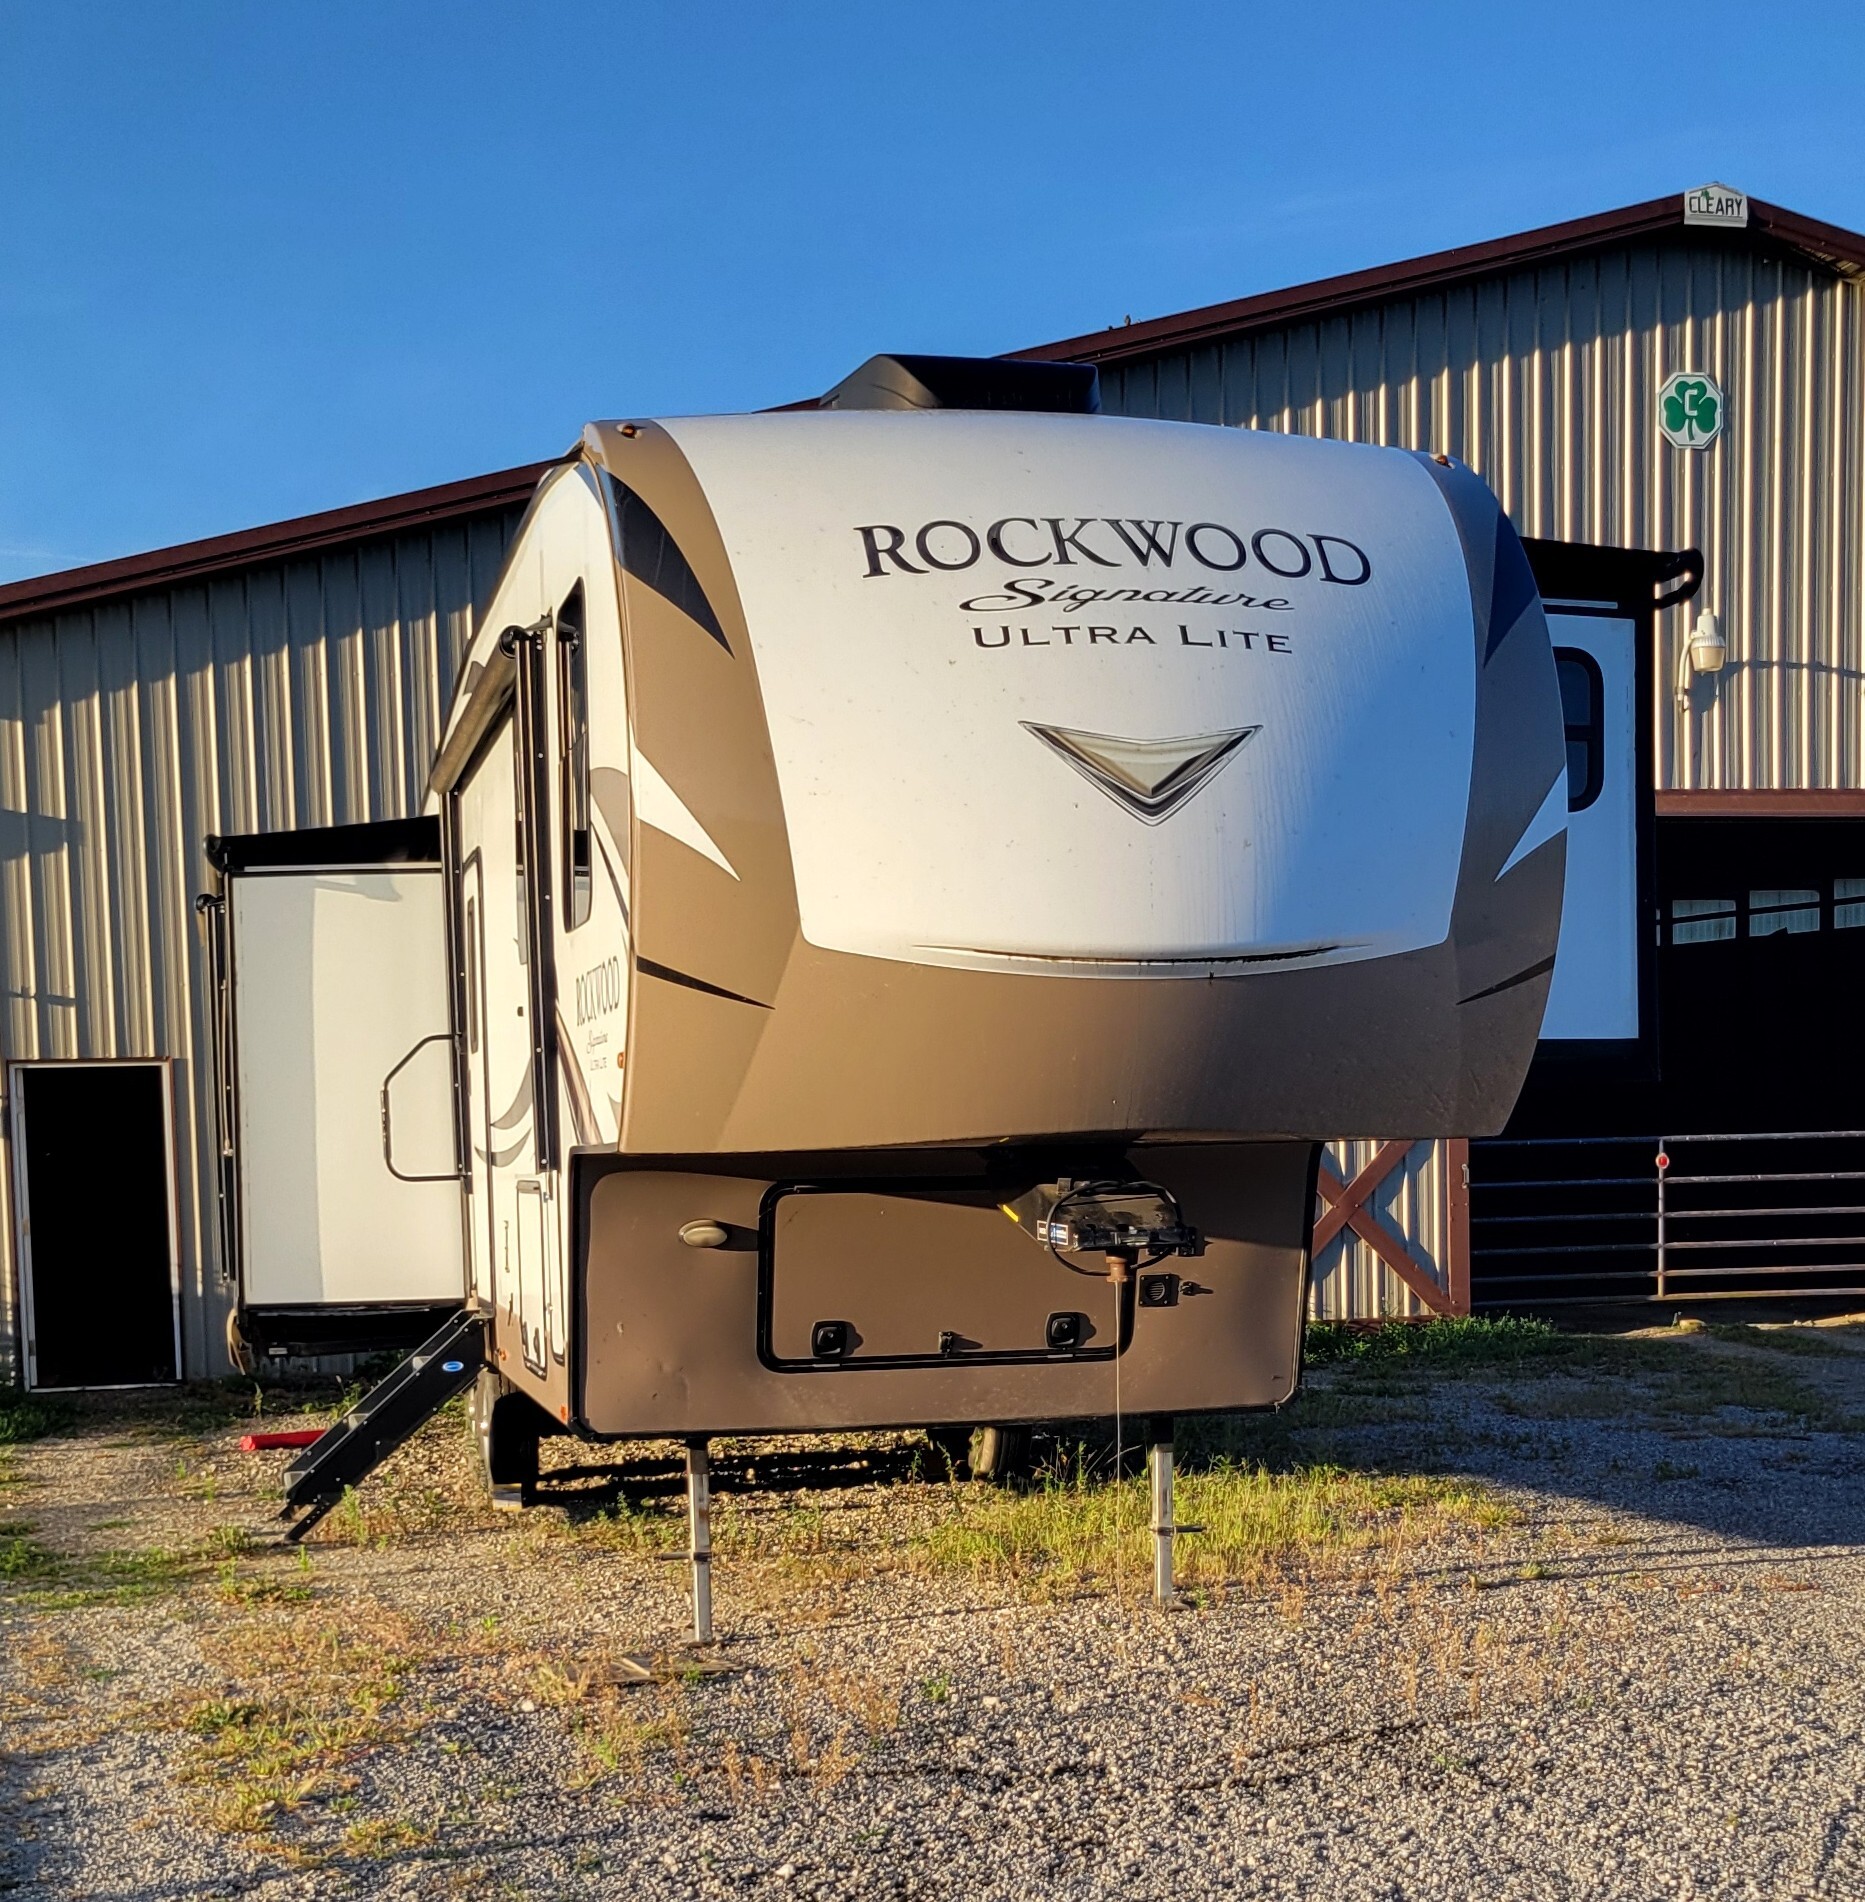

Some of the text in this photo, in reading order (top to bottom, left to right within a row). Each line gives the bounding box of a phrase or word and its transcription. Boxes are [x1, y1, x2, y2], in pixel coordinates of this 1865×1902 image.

[1688, 196, 1743, 215] CLEARY
[1684, 388, 1698, 416] C
[853, 517, 1371, 586] ROCKWOOD
[958, 578, 1295, 613] Signature
[972, 625, 1157, 648] ULTRA
